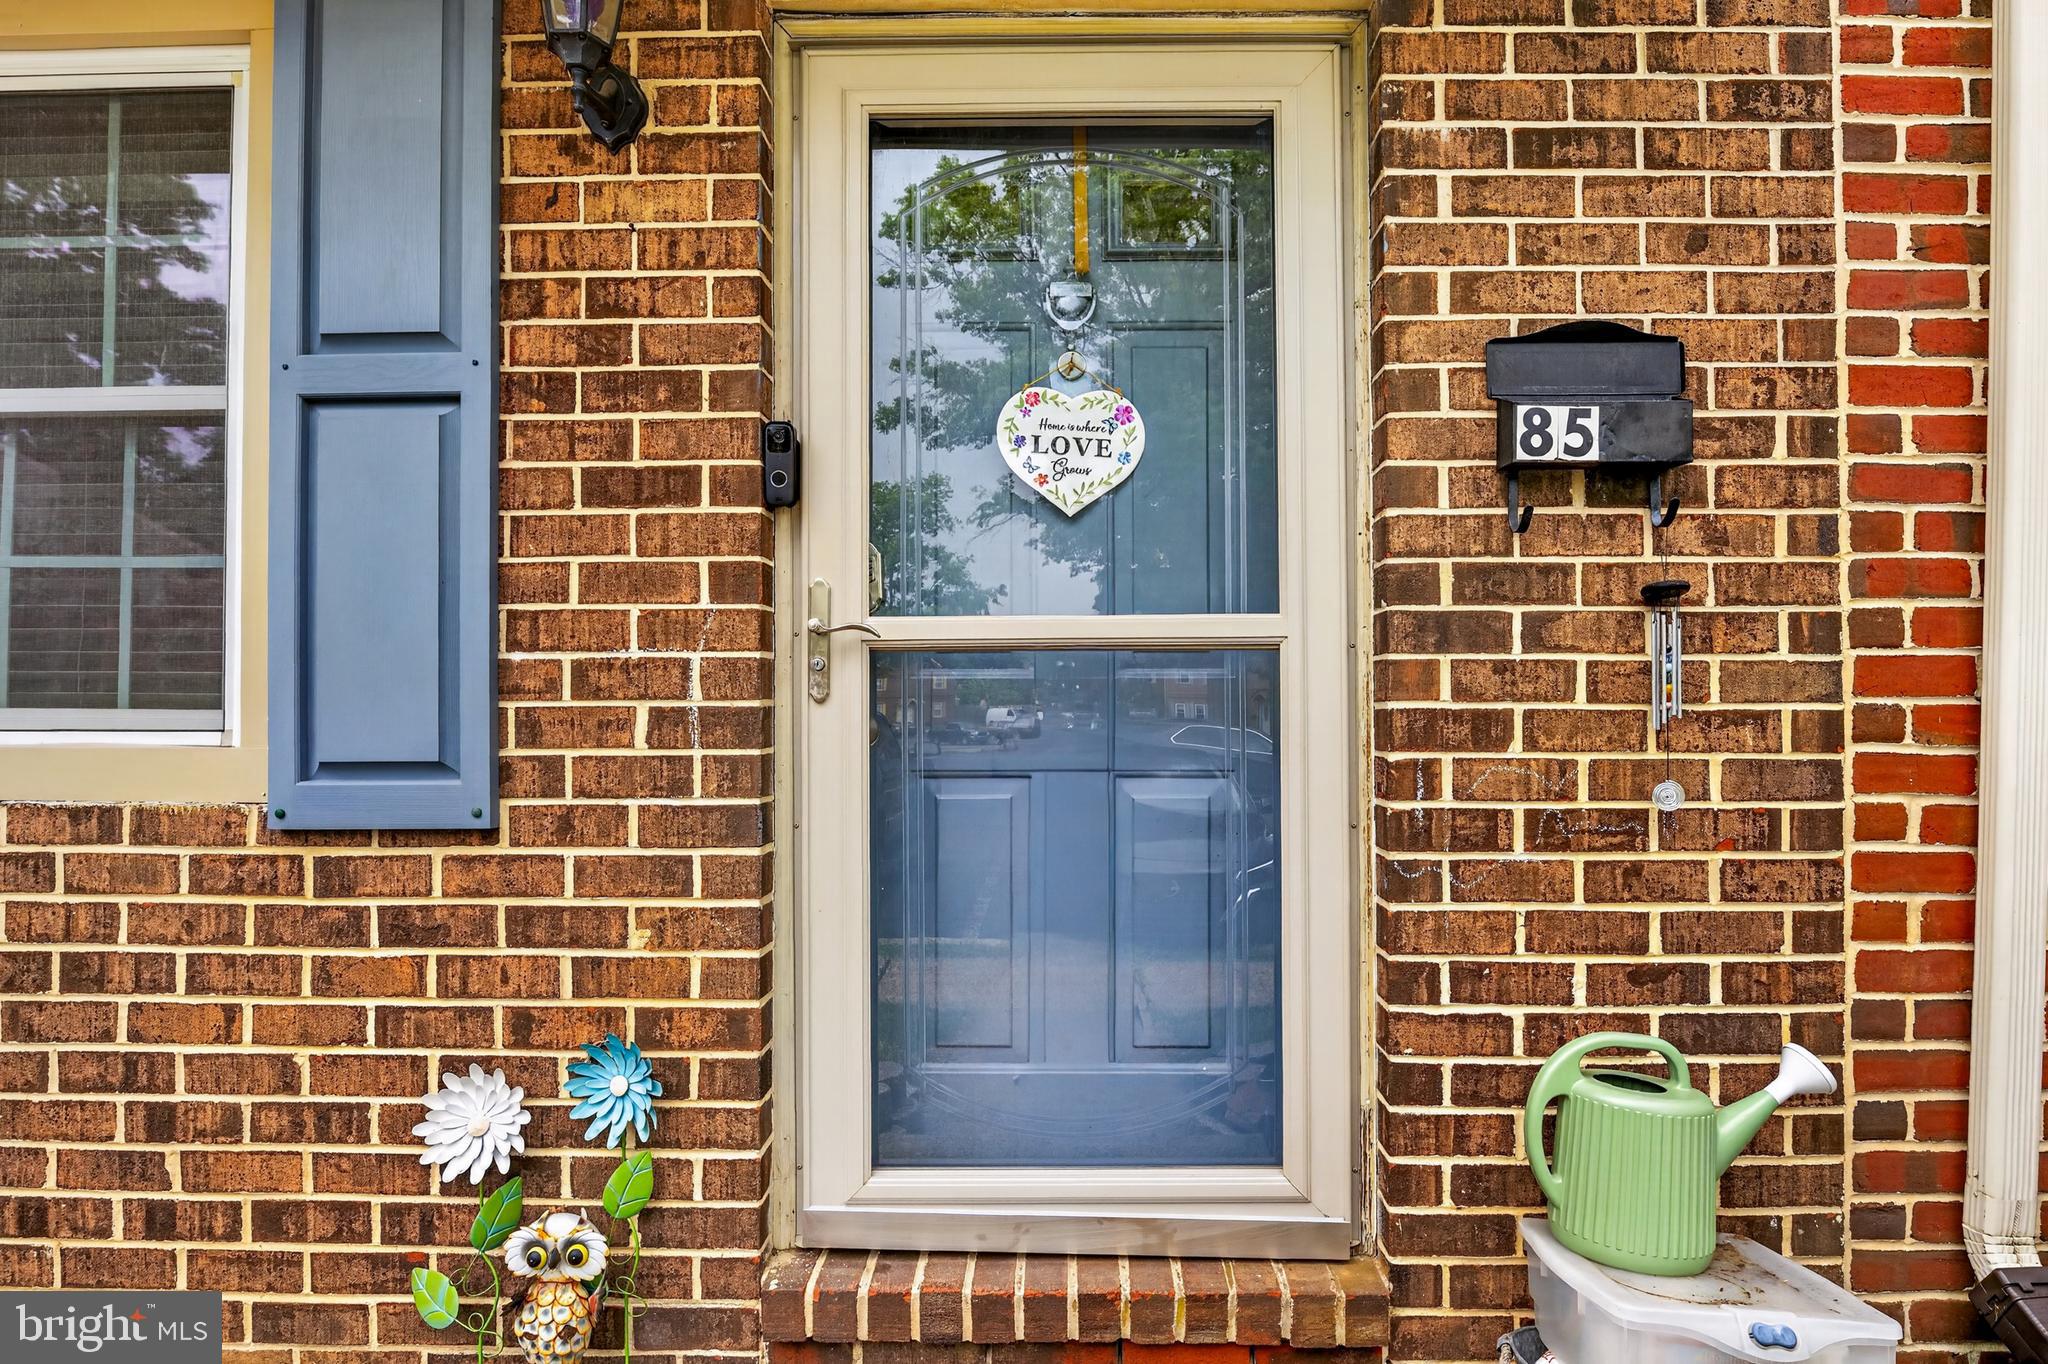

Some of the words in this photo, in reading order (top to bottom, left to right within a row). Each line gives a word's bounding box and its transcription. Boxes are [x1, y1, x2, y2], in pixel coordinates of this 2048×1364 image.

[1038, 417, 1067, 431] Home
[1067, 423, 1076, 431] is
[1076, 419, 1107, 433] where
[1519, 407, 1594, 457] 85
[1031, 434, 1113, 458] LOVE
[1051, 457, 1092, 482] Grows
